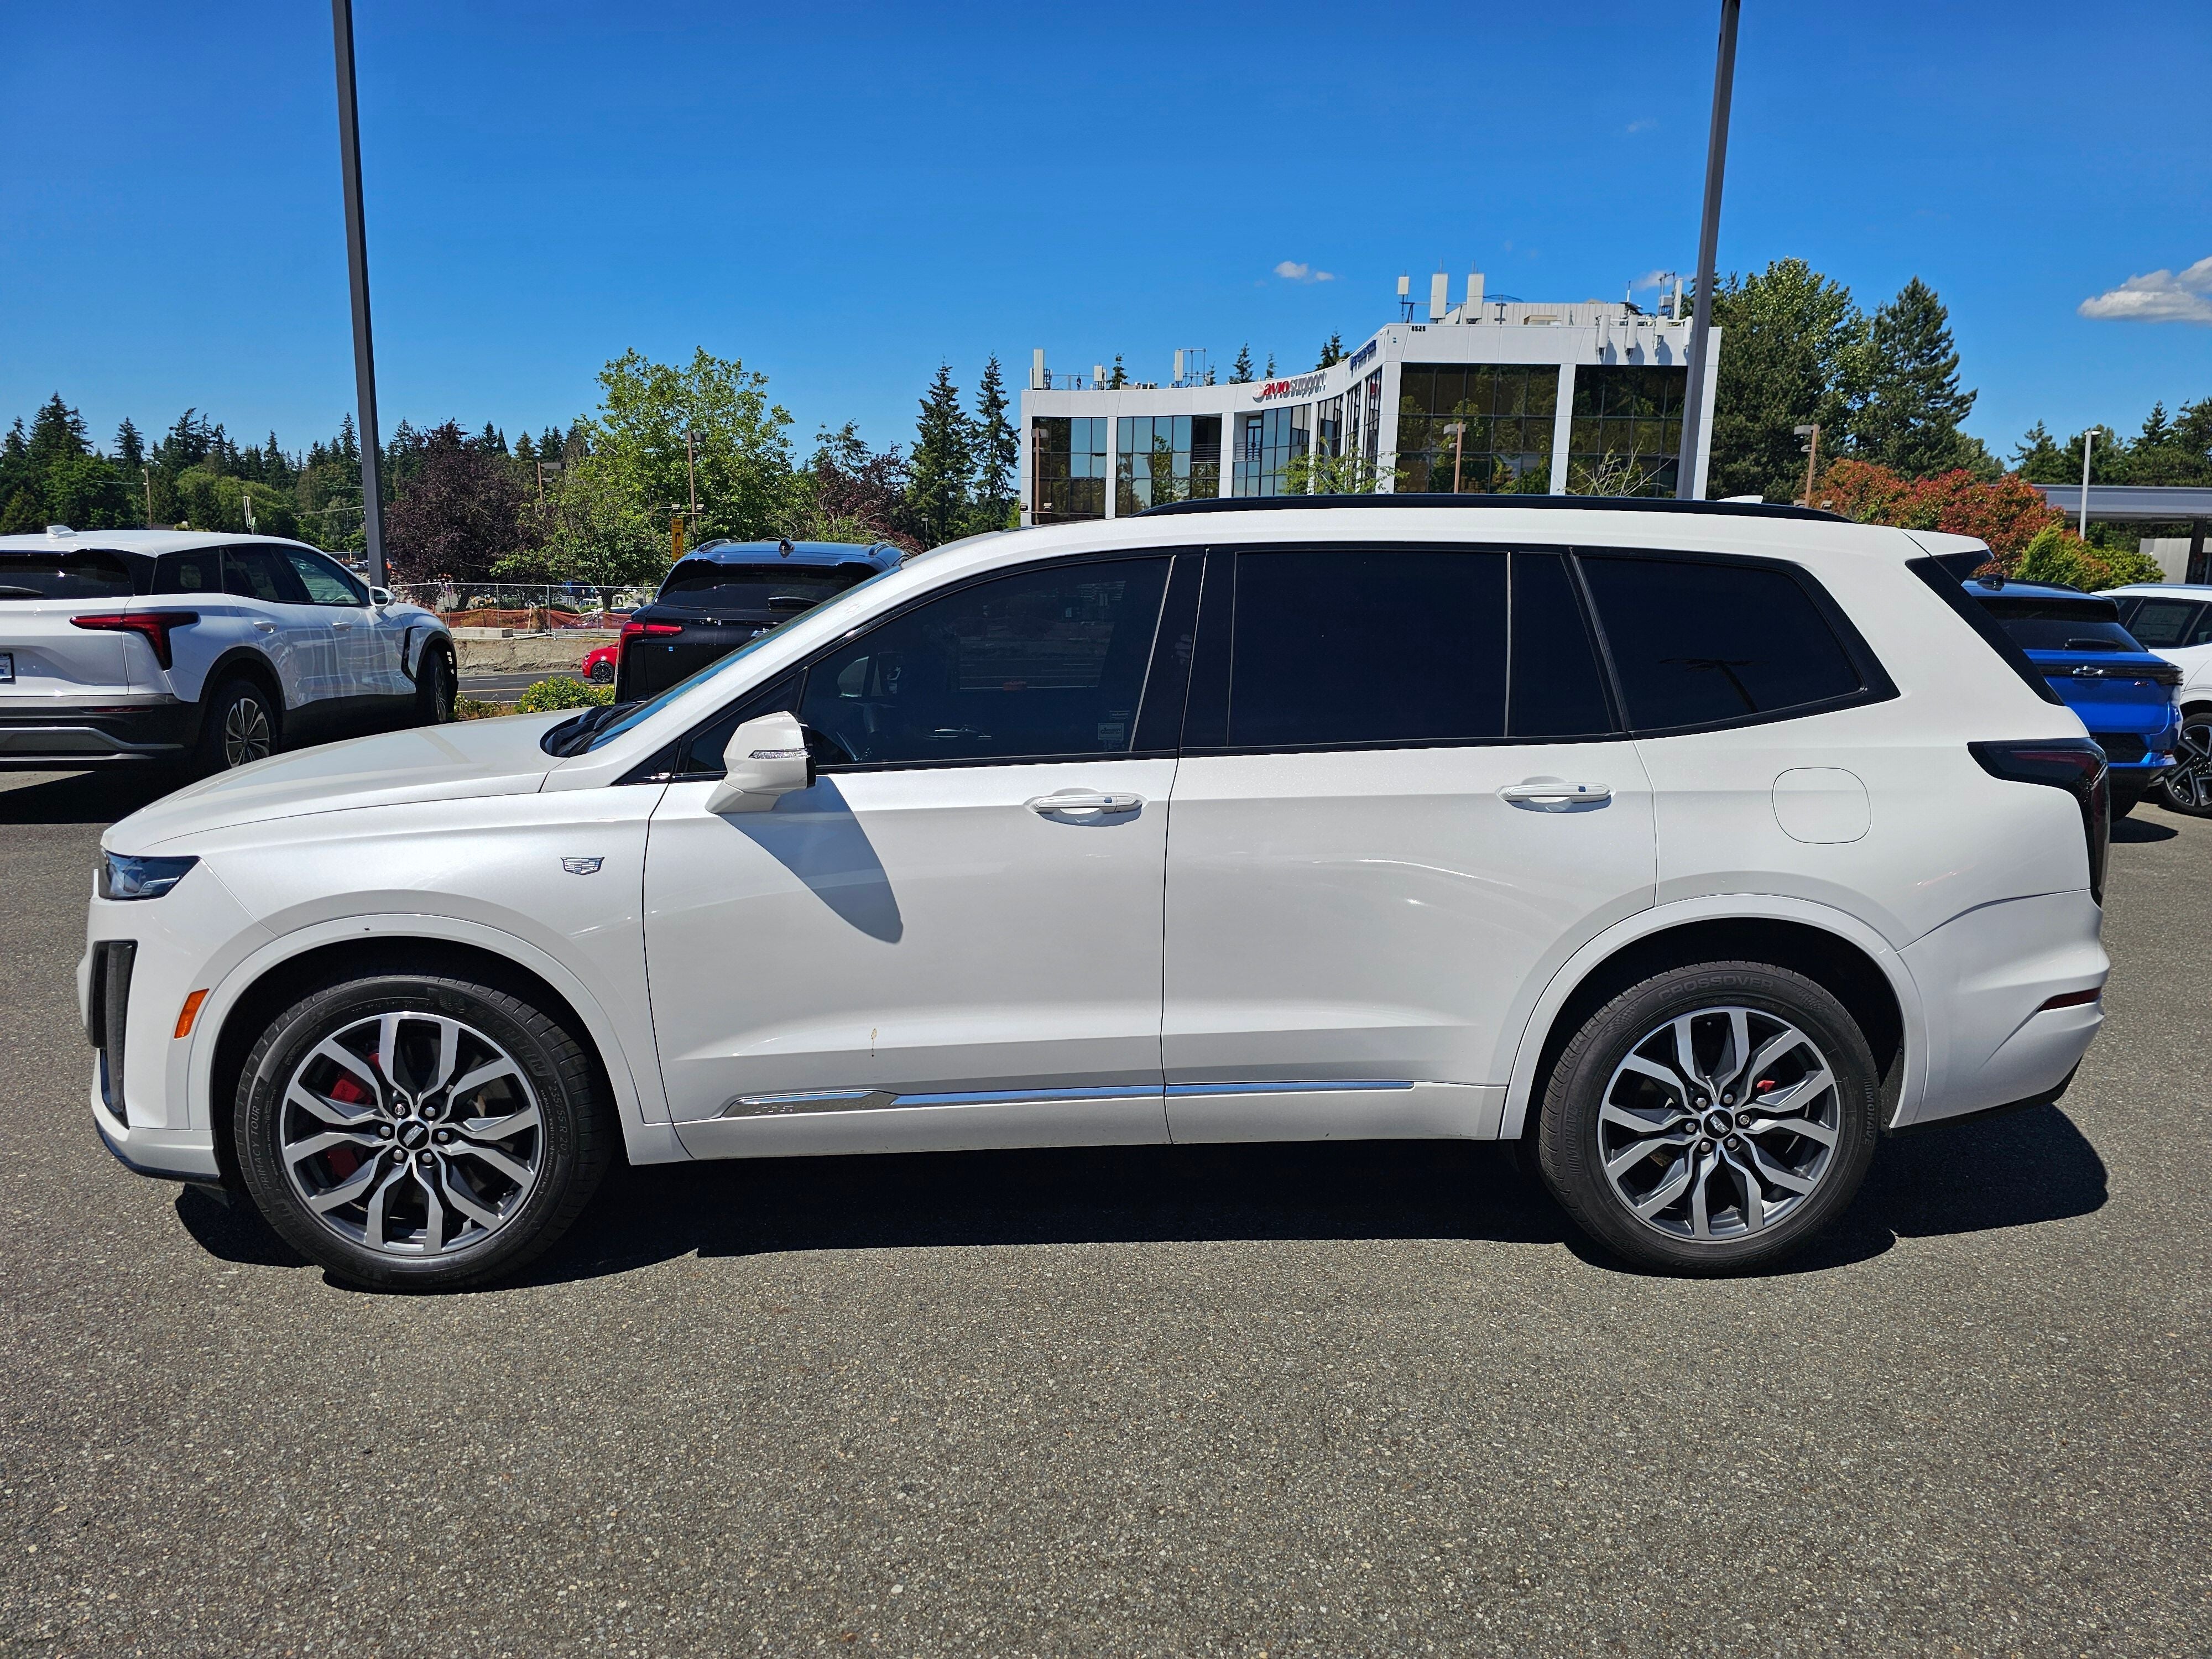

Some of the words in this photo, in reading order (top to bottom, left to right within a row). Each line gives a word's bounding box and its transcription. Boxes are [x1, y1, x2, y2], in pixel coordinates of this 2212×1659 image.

[675, 546, 681, 554] 15
[1659, 974, 1773, 1002] CROSSOVER
[548, 1085, 567, 1122] 235/55
[251, 1105, 260, 1135] TOUR
[559, 1125, 567, 1133] R
[1864, 1092, 1876, 1145] MOHAVE
[559, 1136, 568, 1151] 20
[252, 1140, 273, 1190] PRIMACY
